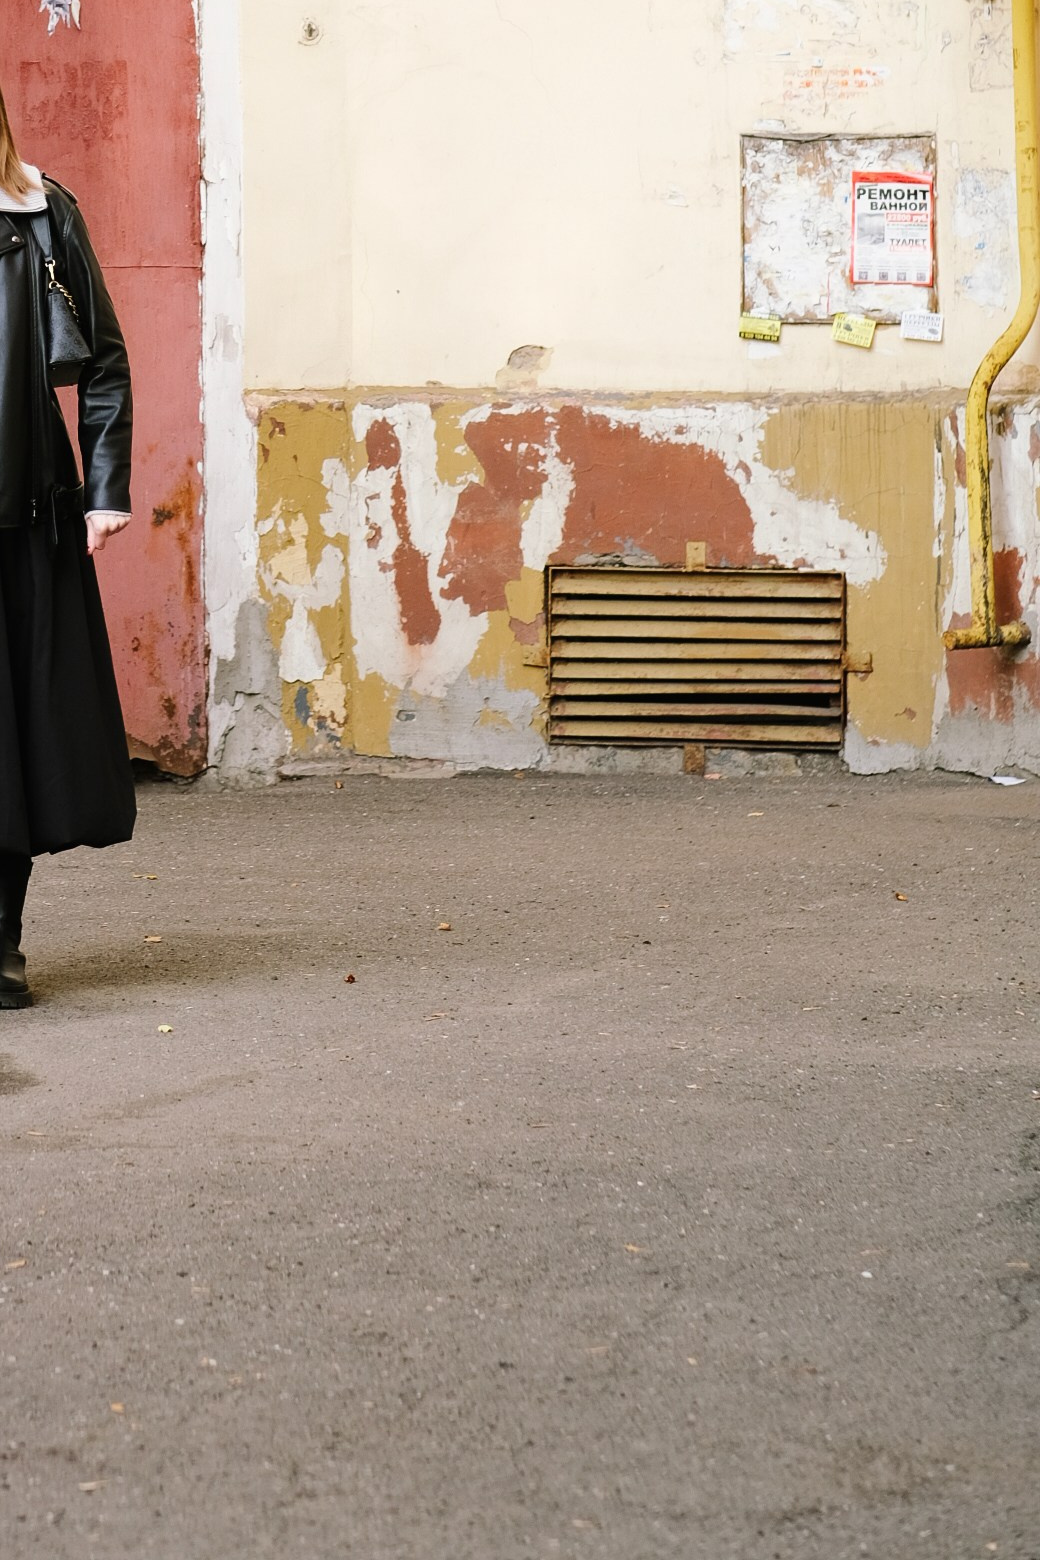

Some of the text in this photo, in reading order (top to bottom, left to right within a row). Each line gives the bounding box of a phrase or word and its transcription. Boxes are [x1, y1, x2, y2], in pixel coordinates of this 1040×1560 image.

[856, 188, 929, 201] РЕМОНТ
[870, 201, 928, 211] ВАННОЙ
[889, 238, 927, 246] ТУАЛЕТ
